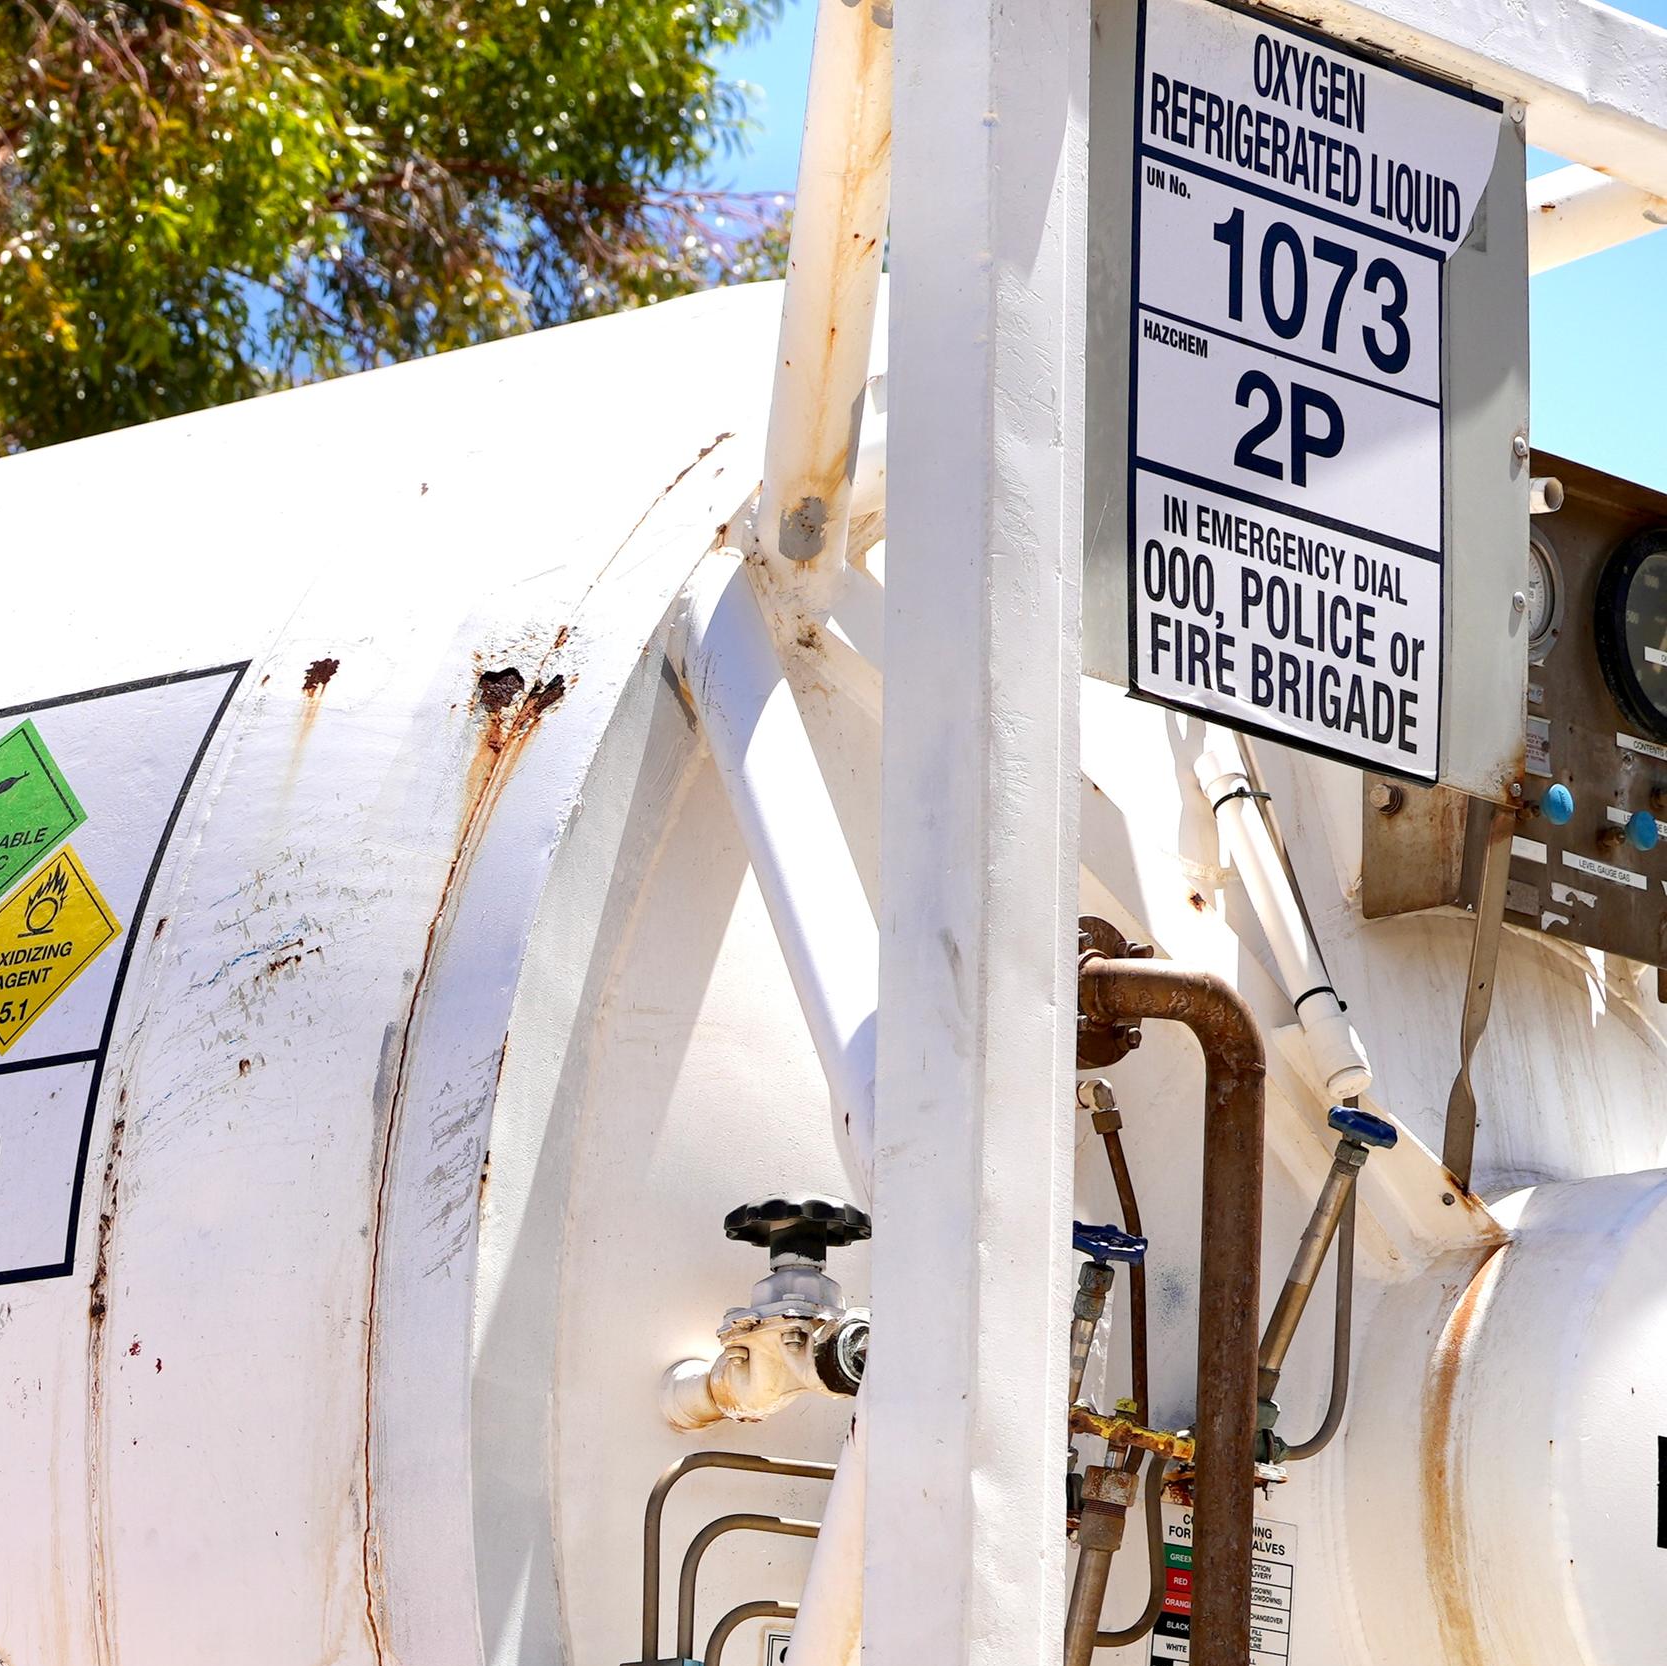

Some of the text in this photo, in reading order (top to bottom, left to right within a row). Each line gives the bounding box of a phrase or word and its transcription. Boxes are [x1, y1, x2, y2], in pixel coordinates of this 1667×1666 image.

[1254, 34, 1364, 133] OXYGEN
[1151, 72, 1460, 242] REFRIGERATED LIQUID
[1147, 166, 1190, 199] UN No.
[1214, 207, 1410, 374] 1073
[1144, 319, 1207, 358] HAZCHEM
[1234, 370, 1344, 487] 2P
[1164, 495, 1407, 606] IN EMERGENCY DIAL
[1145, 540, 1424, 681] 000, POLICE or
[1151, 613, 1418, 754] FIRE BRIGADE
[1579, 859, 1630, 882] LEVEL GAUGE GAS
[1169, 1526, 1285, 1555] FOR ALVES
[1251, 1527, 1272, 1539] ING
[1173, 1577, 1188, 1586] RED
[1166, 1621, 1189, 1631] BLACK
[1166, 1643, 1187, 1653] WHITE
